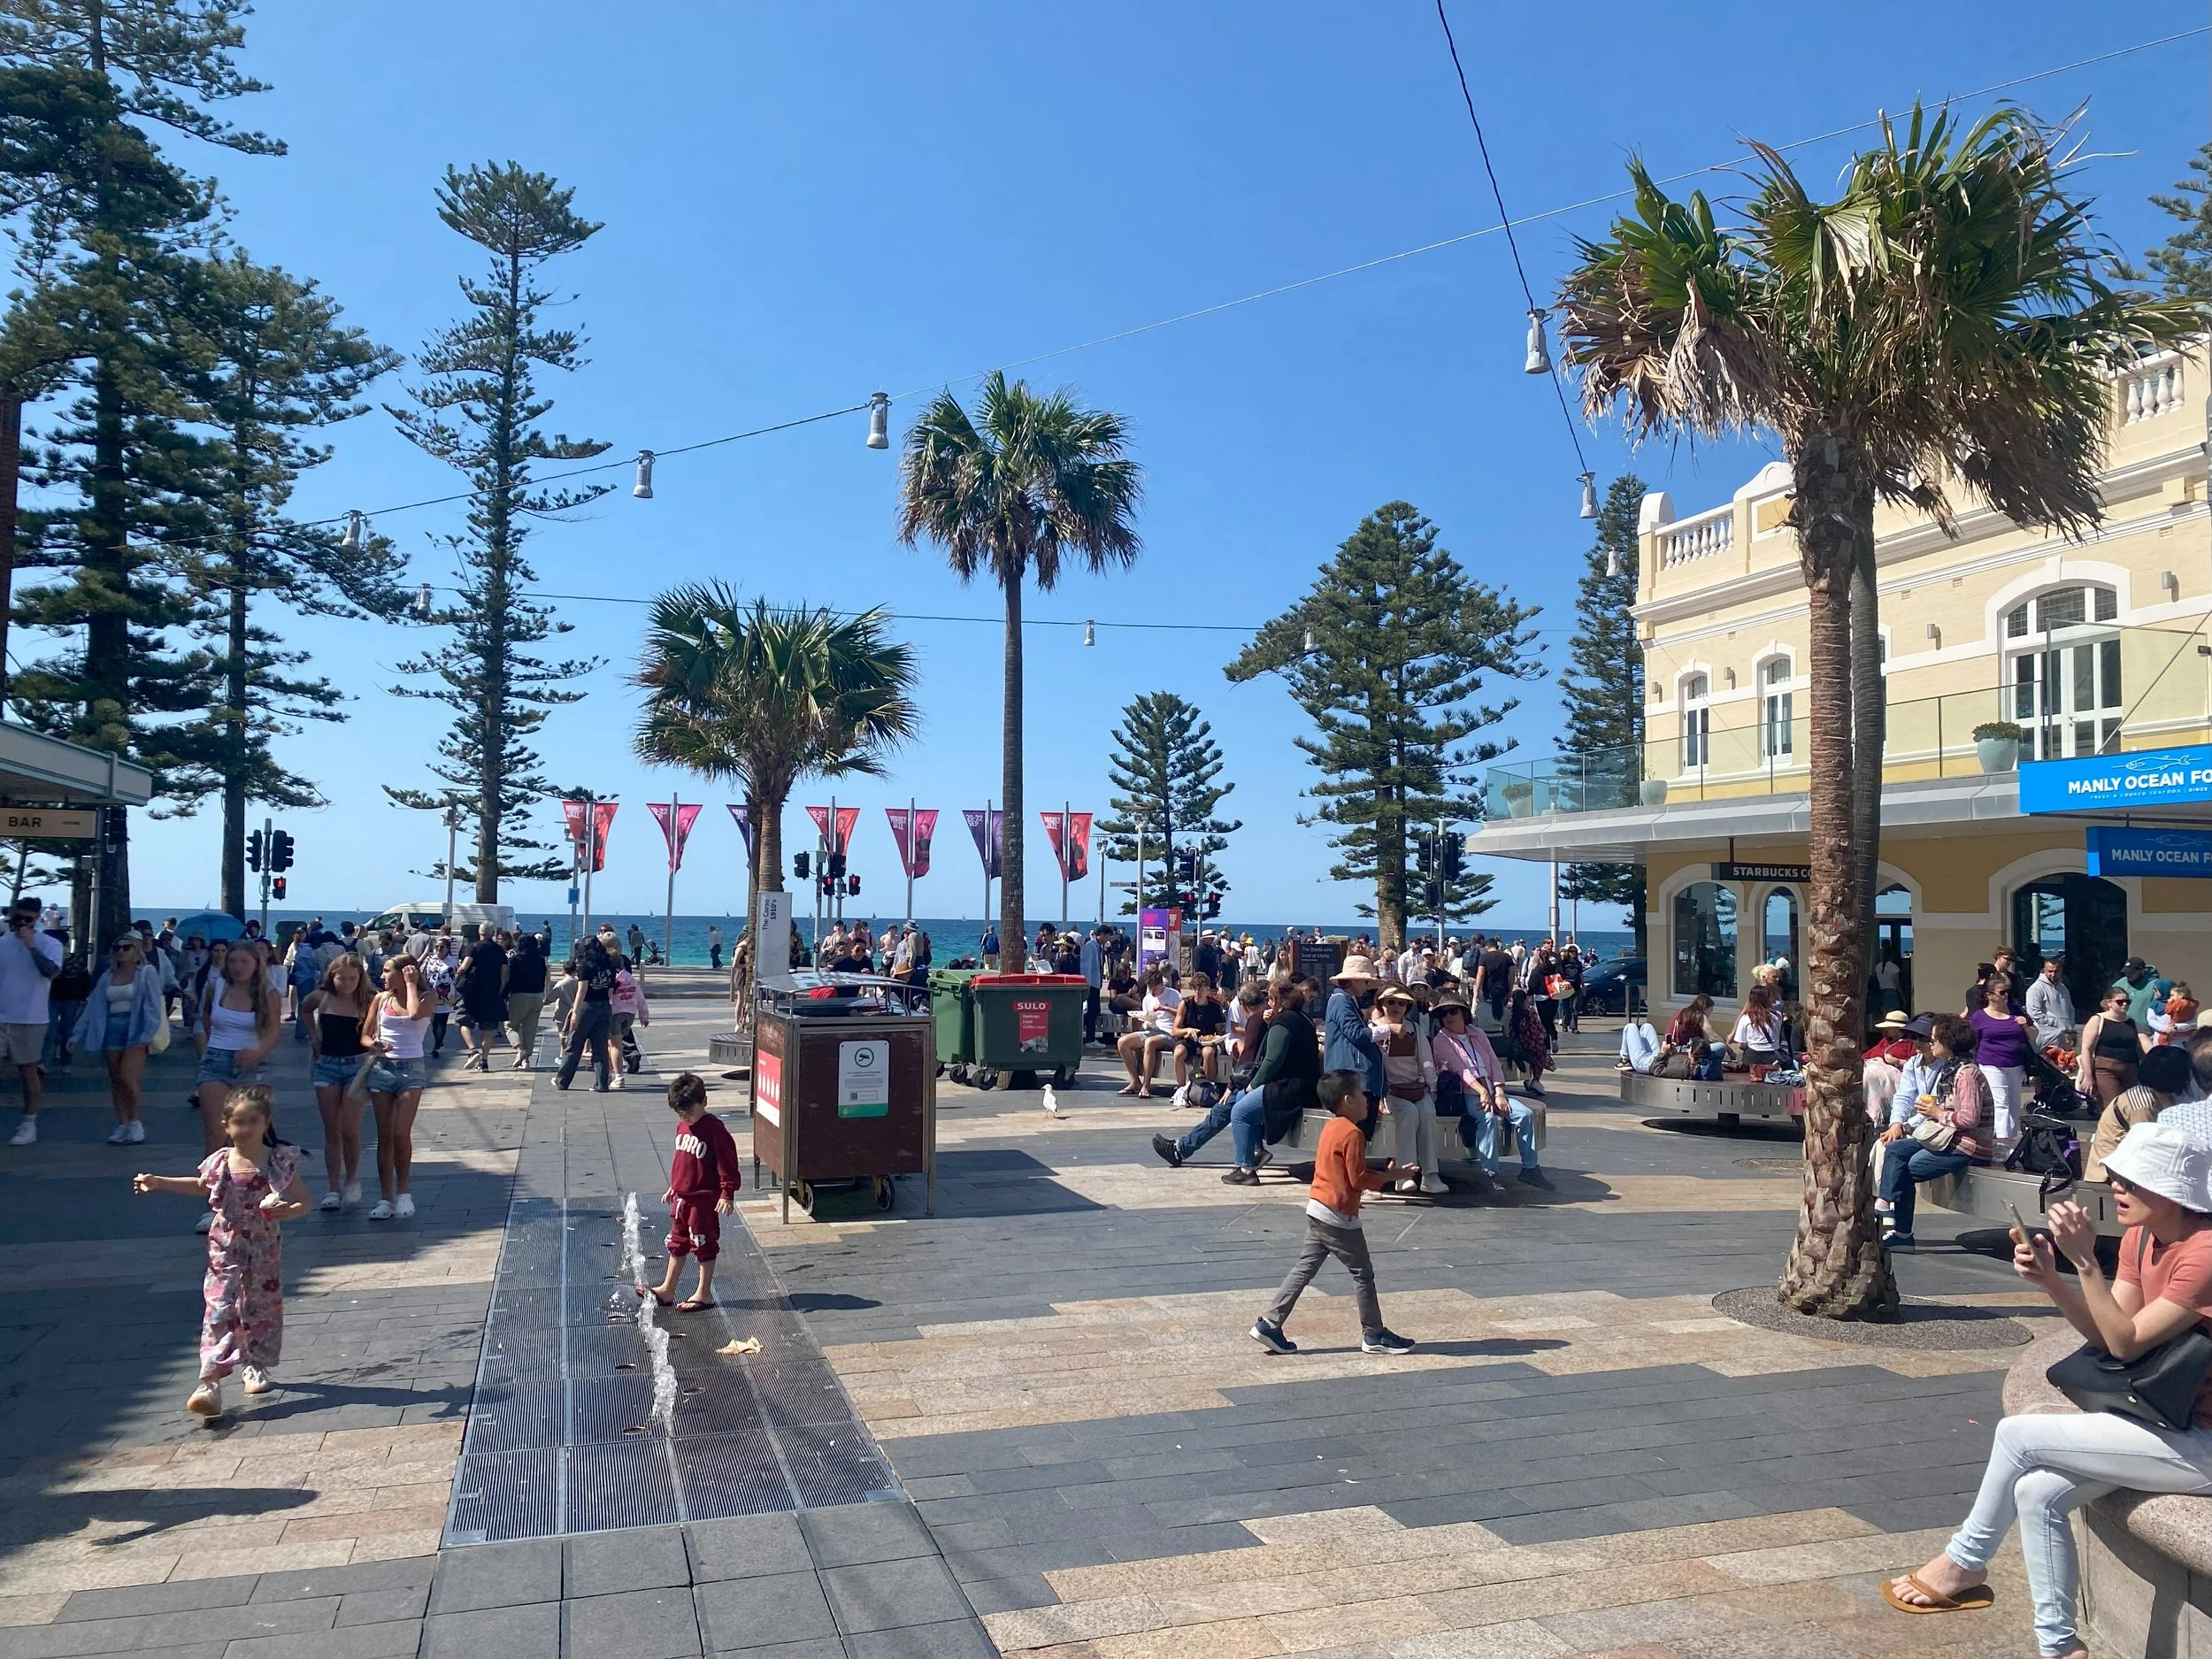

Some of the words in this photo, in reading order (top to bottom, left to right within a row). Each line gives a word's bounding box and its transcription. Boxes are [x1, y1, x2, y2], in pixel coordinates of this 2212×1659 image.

[2068, 777, 2122, 795] MANLY
[2124, 772, 2185, 789] OCEAN
[8, 816, 42, 827] BAR
[2111, 849, 2154, 862] MANLY
[2156, 850, 2200, 864] OCEAN
[2203, 852, 2212, 864] F
[1733, 867, 1798, 877] STARBUCKS
